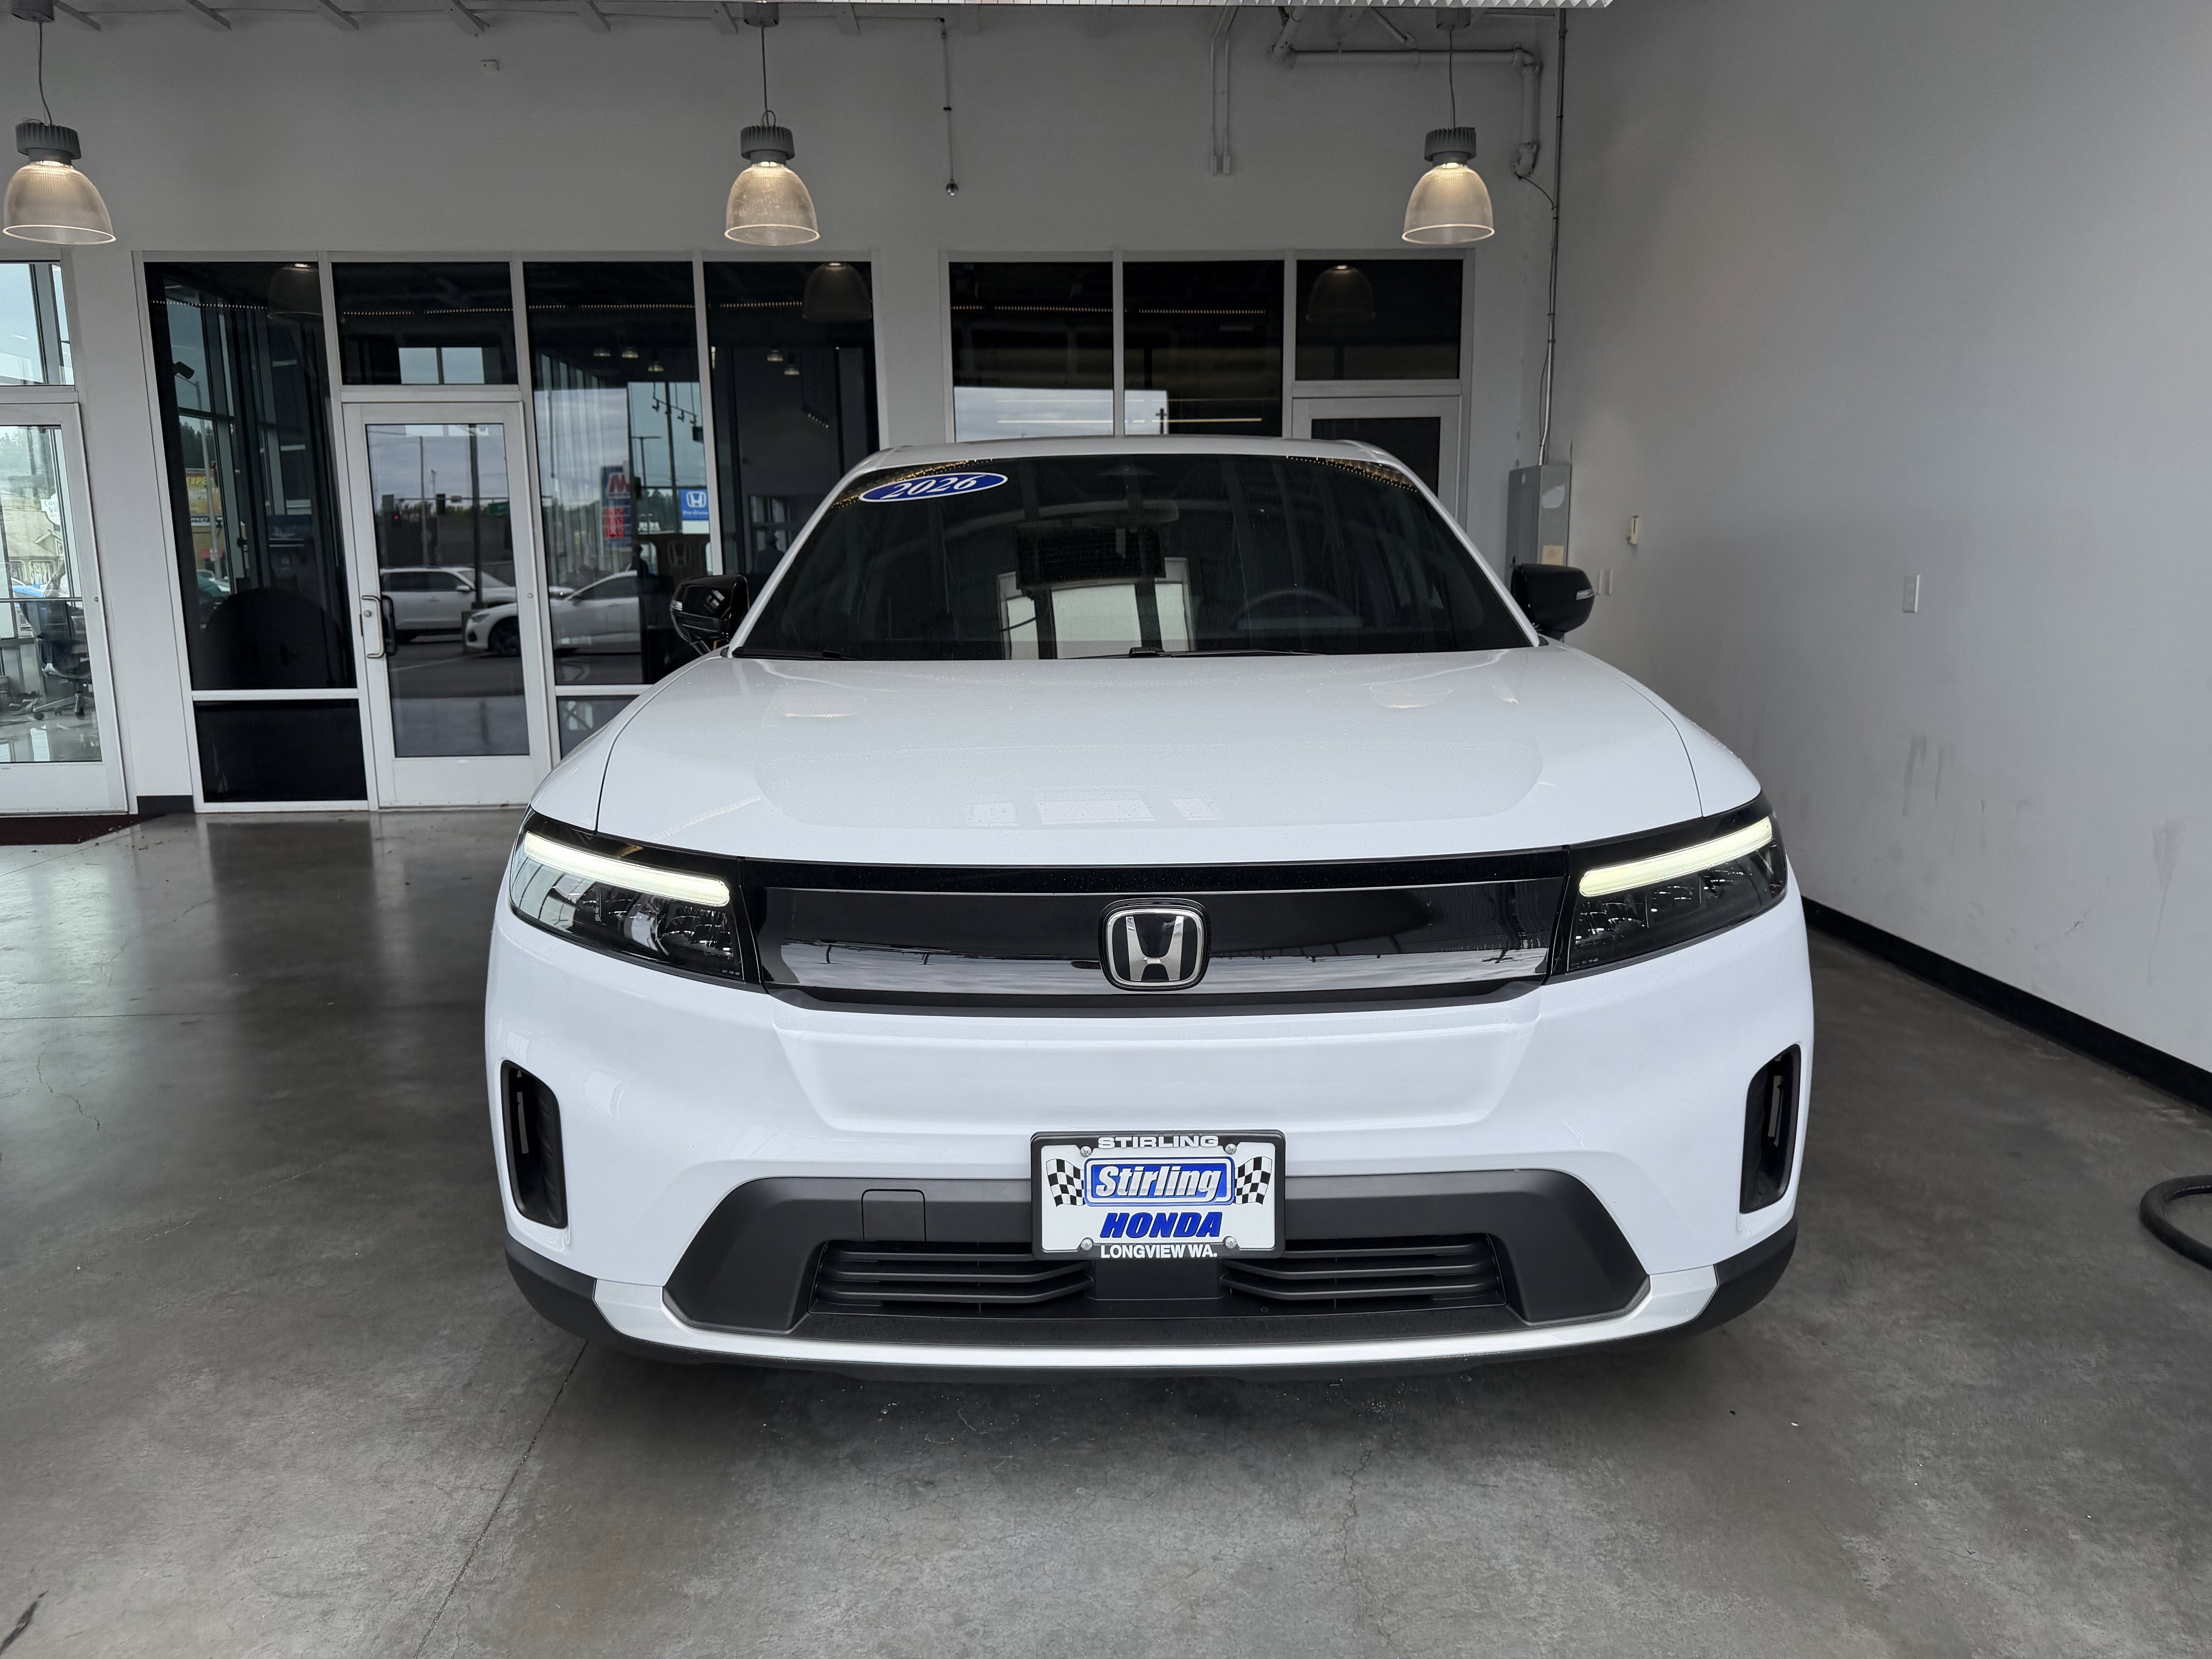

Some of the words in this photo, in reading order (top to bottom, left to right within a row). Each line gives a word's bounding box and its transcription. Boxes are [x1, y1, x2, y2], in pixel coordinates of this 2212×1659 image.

[880, 475, 986, 500] 2026
[1098, 1135, 1219, 1149] STIRLING
[1096, 1166, 1222, 1202] Stirling
[1099, 1212, 1223, 1238] HONDA
[1101, 1244, 1186, 1258] LONGVIEW
[1188, 1244, 1218, 1257] WA.
